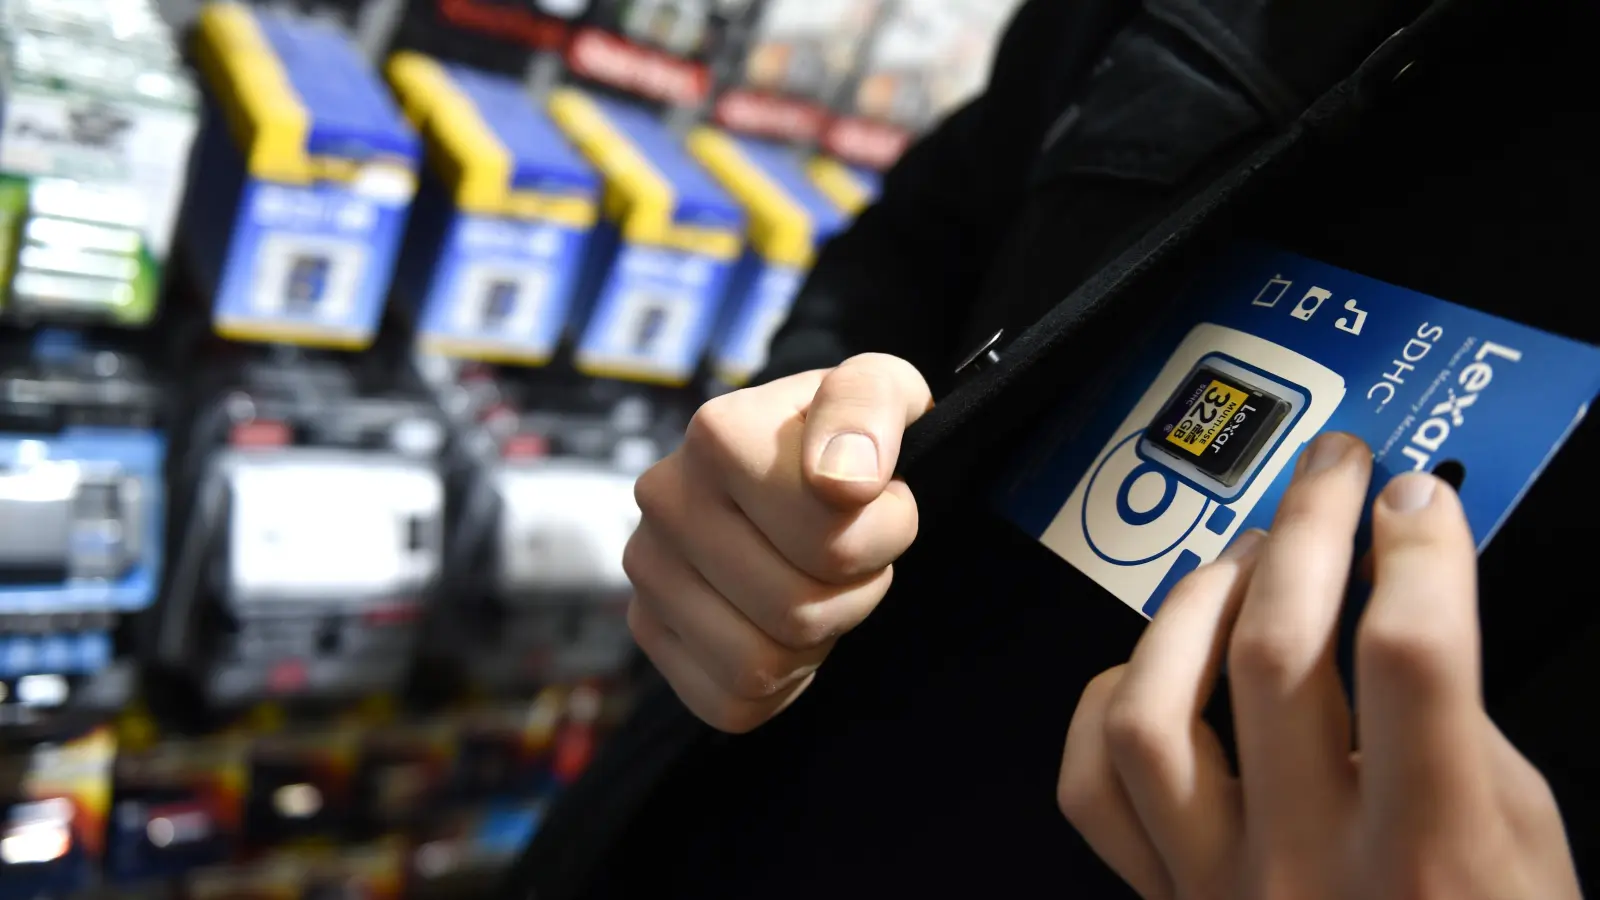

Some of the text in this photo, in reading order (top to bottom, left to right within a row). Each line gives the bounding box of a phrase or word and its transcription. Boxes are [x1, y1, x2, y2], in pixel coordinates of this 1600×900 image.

[1186, 383, 1207, 407] SDHC
[1189, 386, 1231, 424] 32
[1402, 341, 1522, 472] Lexar
[1411, 369, 1450, 412] Memory
[1199, 402, 1237, 445] MULTI-USE
[1210, 404, 1257, 453] Lexar
